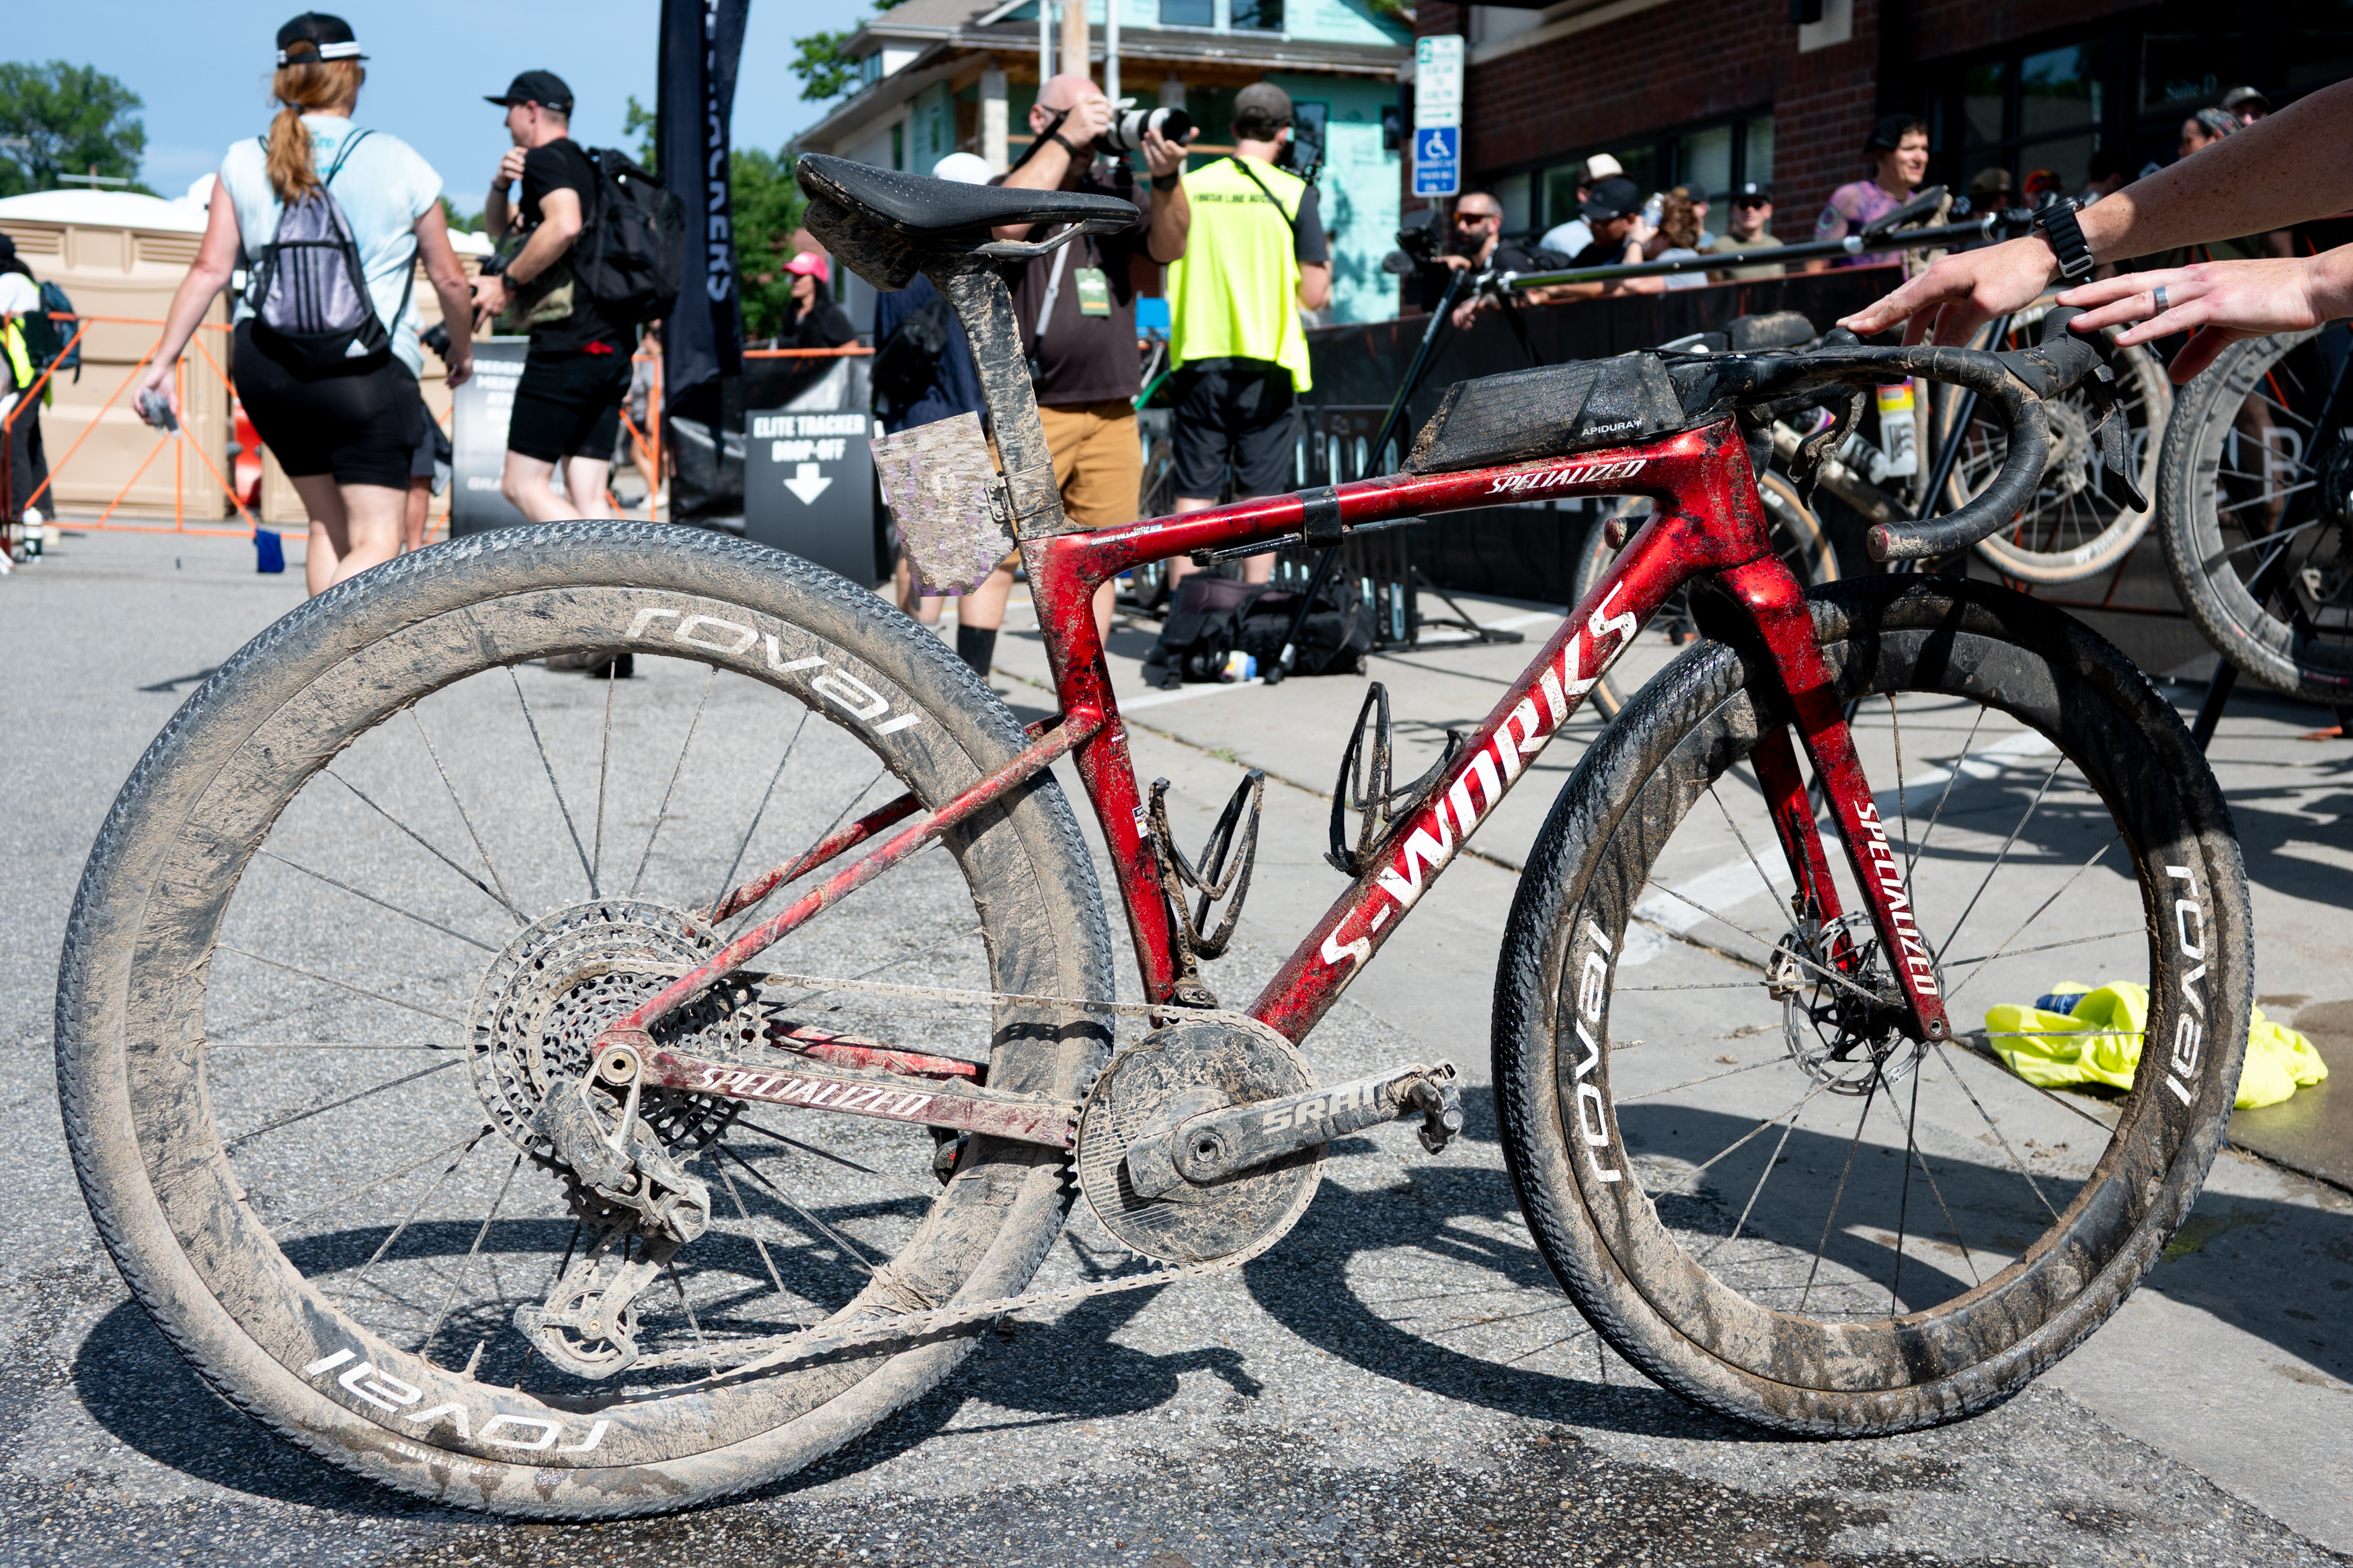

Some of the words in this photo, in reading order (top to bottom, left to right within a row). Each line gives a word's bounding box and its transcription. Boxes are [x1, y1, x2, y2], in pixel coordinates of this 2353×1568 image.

[753, 416, 796, 438] ELITE
[797, 414, 866, 436] TRACKER
[1582, 421, 1634, 436] APIDURA
[772, 438, 846, 462] DROP-OFF
[1484, 459, 1647, 495] SPECIALIZED
[1091, 534, 1115, 545] GOMEZ
[1322, 581, 1636, 994] S-WORKS
[1853, 800, 1939, 996] SPECIALIZED
[694, 1066, 933, 1117] SPECIALIZED
